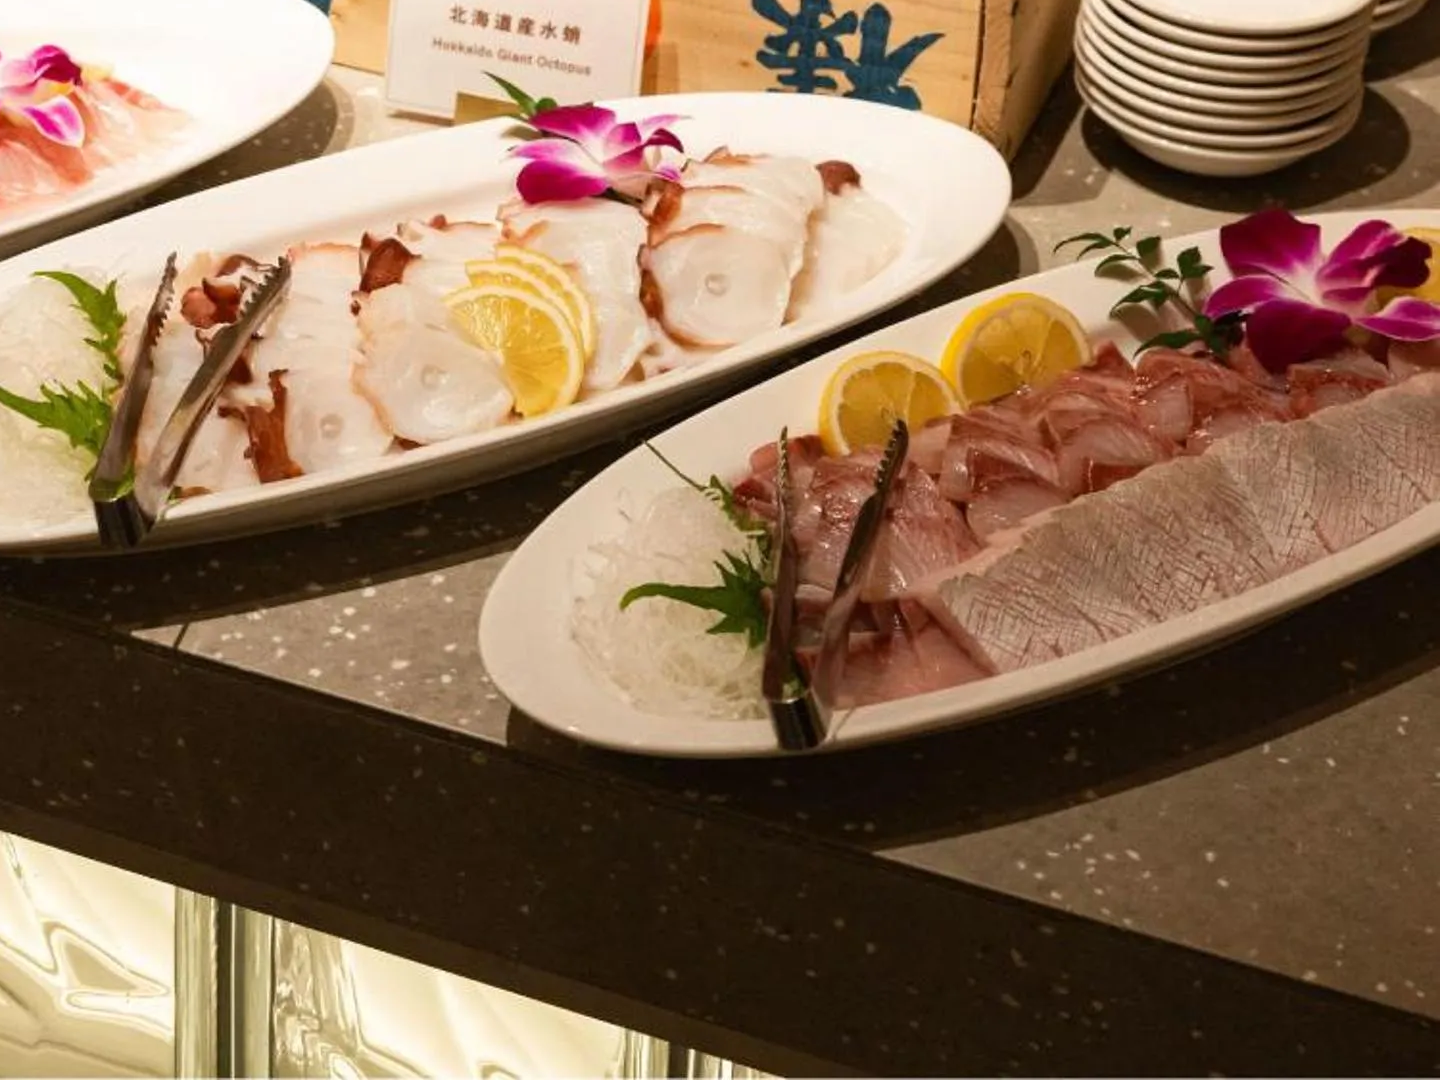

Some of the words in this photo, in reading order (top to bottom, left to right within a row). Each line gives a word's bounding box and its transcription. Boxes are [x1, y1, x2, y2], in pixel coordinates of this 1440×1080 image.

[432, 36, 493, 58] Hokkaido
[497, 48, 533, 66] Giant
[536, 56, 592, 76] Octopus
